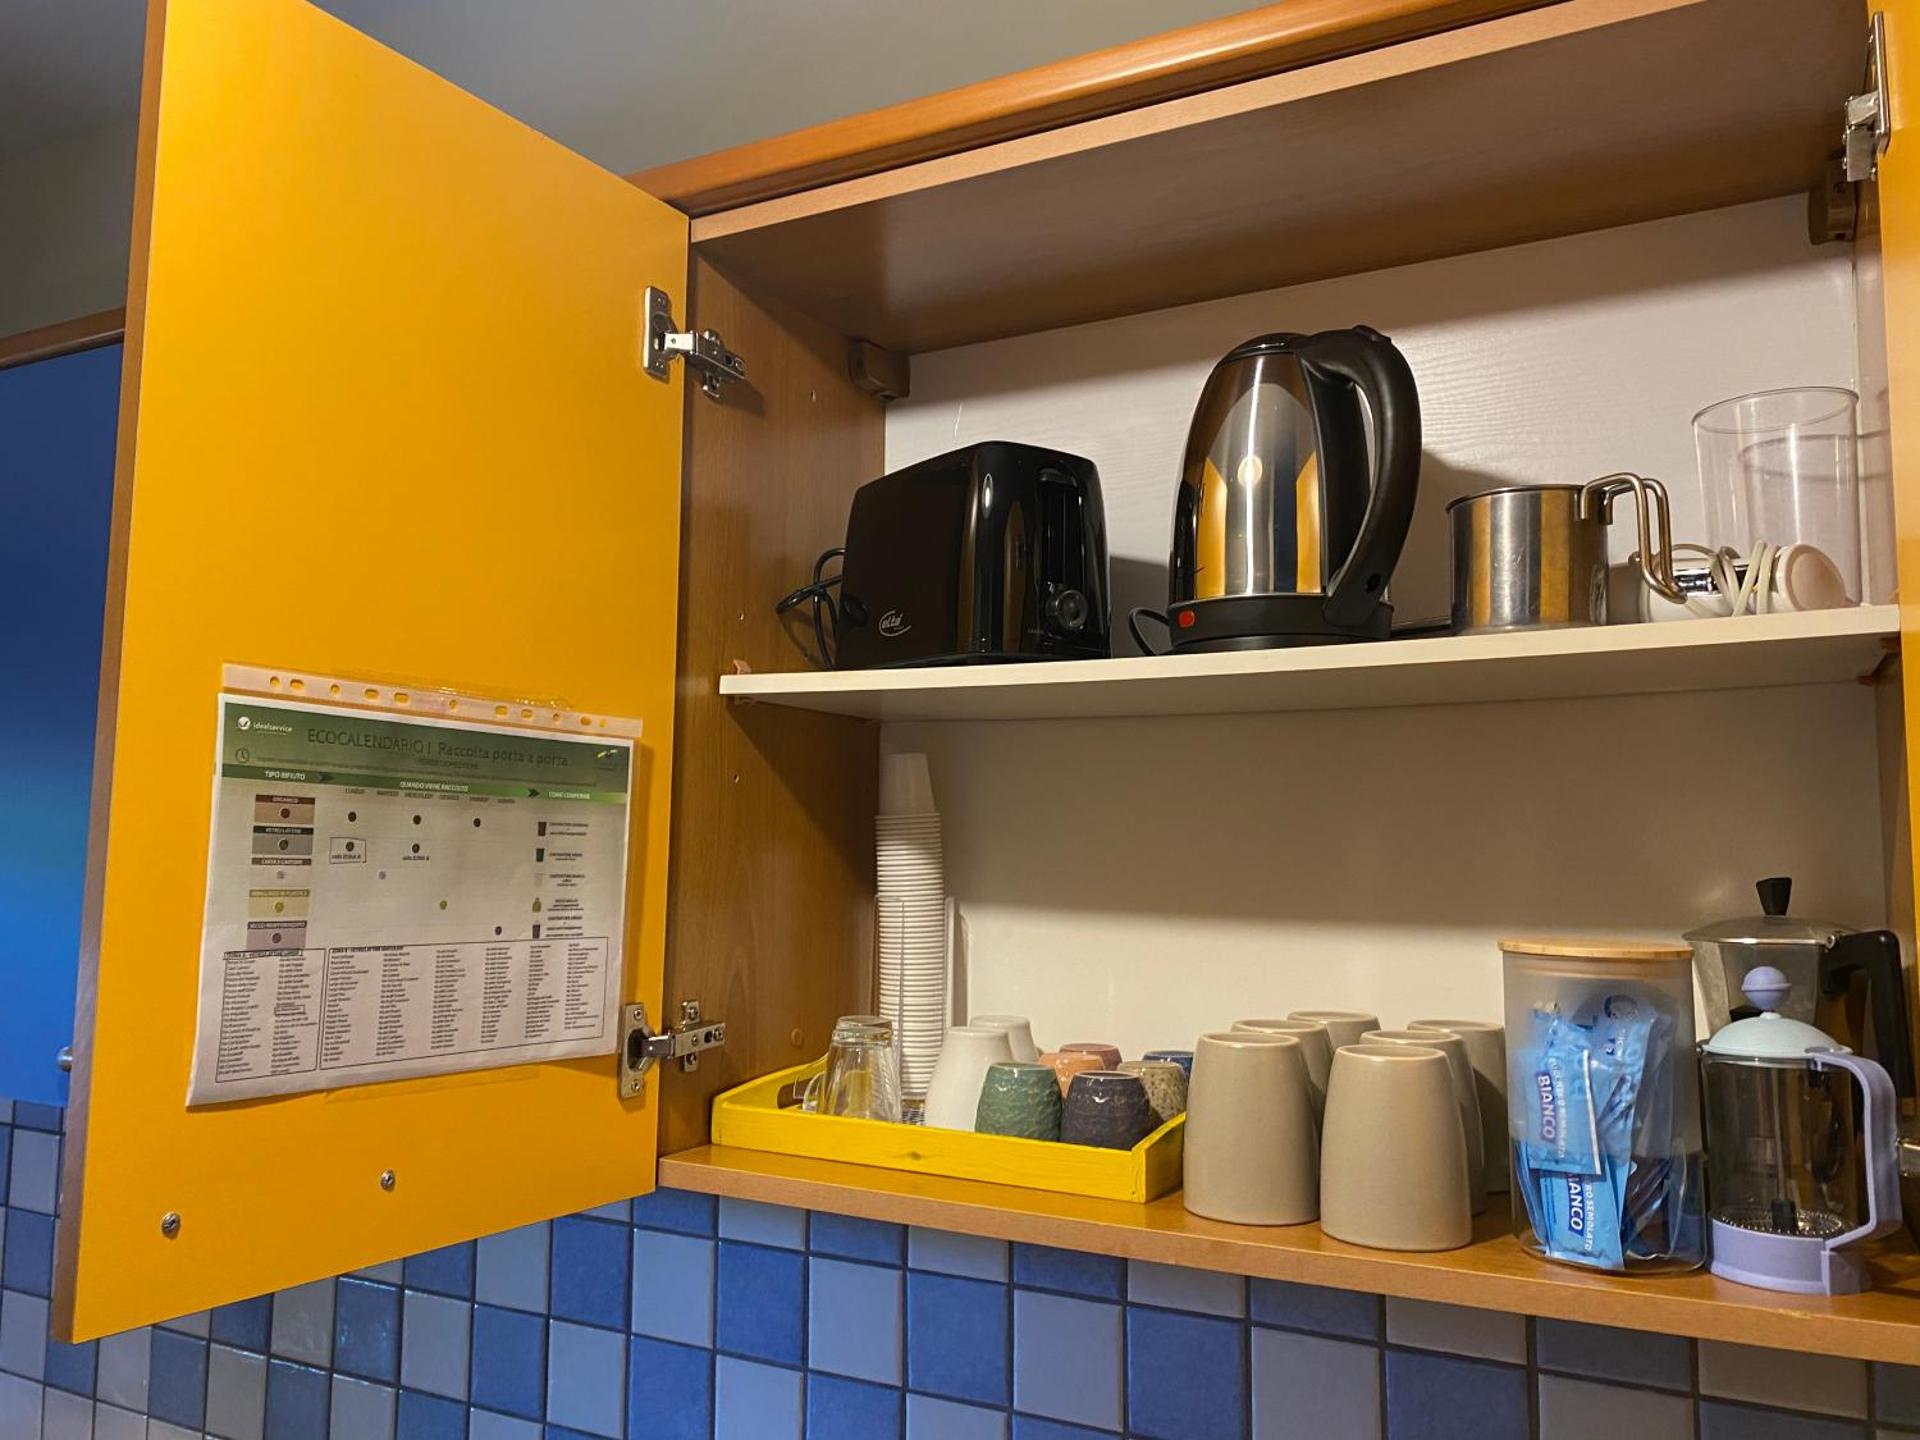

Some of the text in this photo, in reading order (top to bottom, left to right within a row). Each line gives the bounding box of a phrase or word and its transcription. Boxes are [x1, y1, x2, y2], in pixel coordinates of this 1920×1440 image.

[253, 721, 293, 732] idealservice
[307, 728, 424, 754] ECOCALENDARIO
[437, 742, 489, 760] Raccolta
[492, 750, 525, 765] porta
[536, 753, 568, 769] porta
[264, 770, 280, 778] TIPO
[1538, 1074, 1556, 1140] BIANCO
[1567, 1174, 1584, 1231] IANCO
[1584, 1201, 1595, 1252] SEMOLATO
